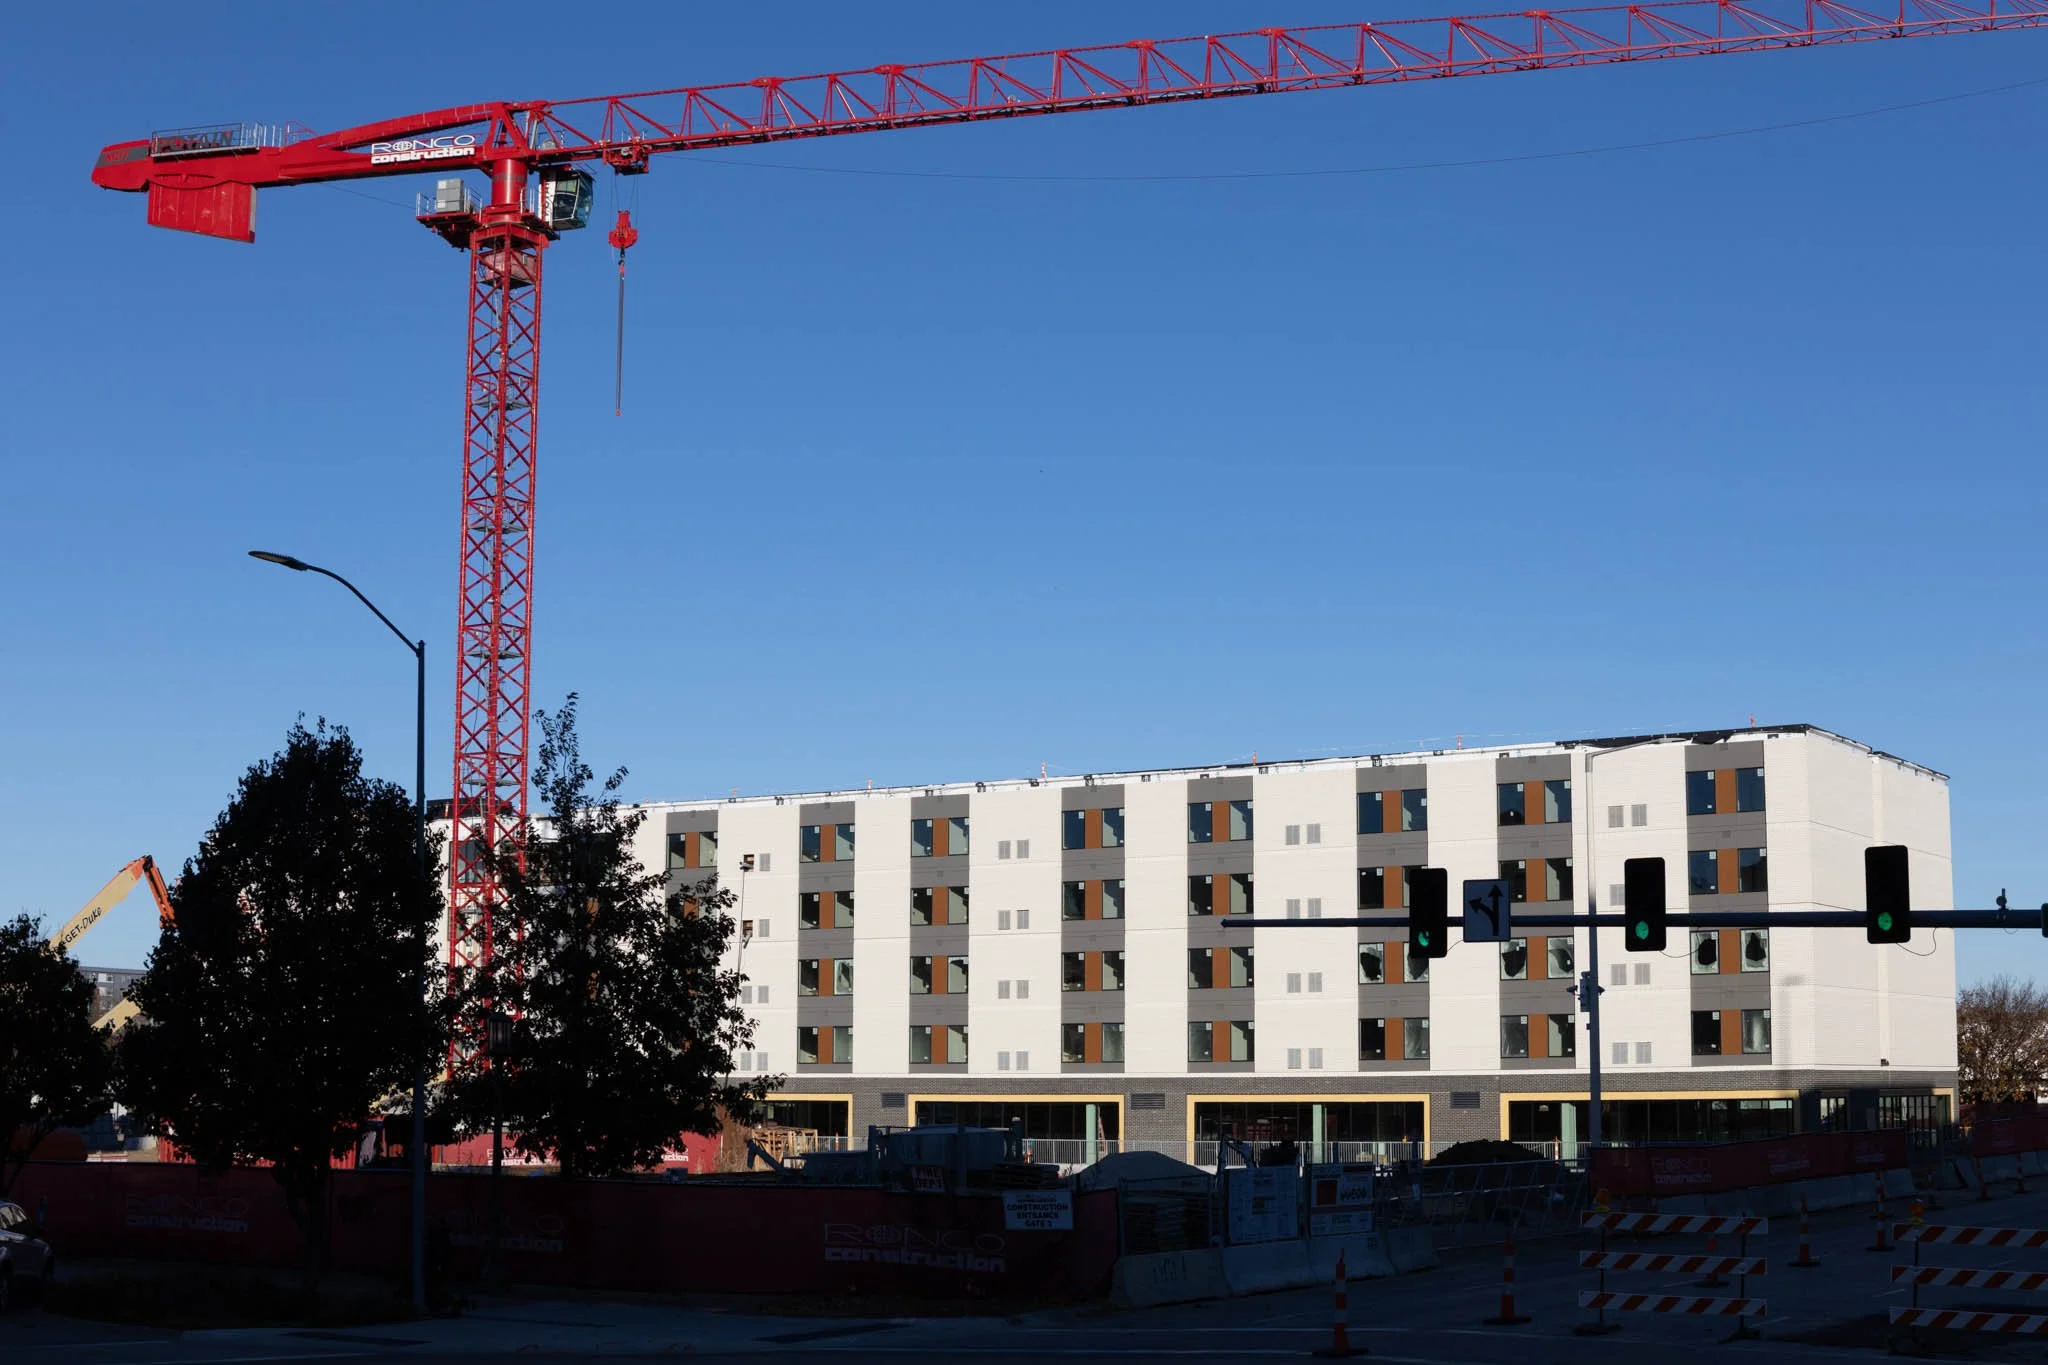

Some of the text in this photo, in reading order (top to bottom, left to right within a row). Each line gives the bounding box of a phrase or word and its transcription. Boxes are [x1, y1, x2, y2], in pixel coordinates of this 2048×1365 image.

[371, 135, 475, 154] RONCO
[371, 147, 475, 165] construction
[824, 1223, 1006, 1253] RONCO
[824, 1246, 1006, 1273] construction
